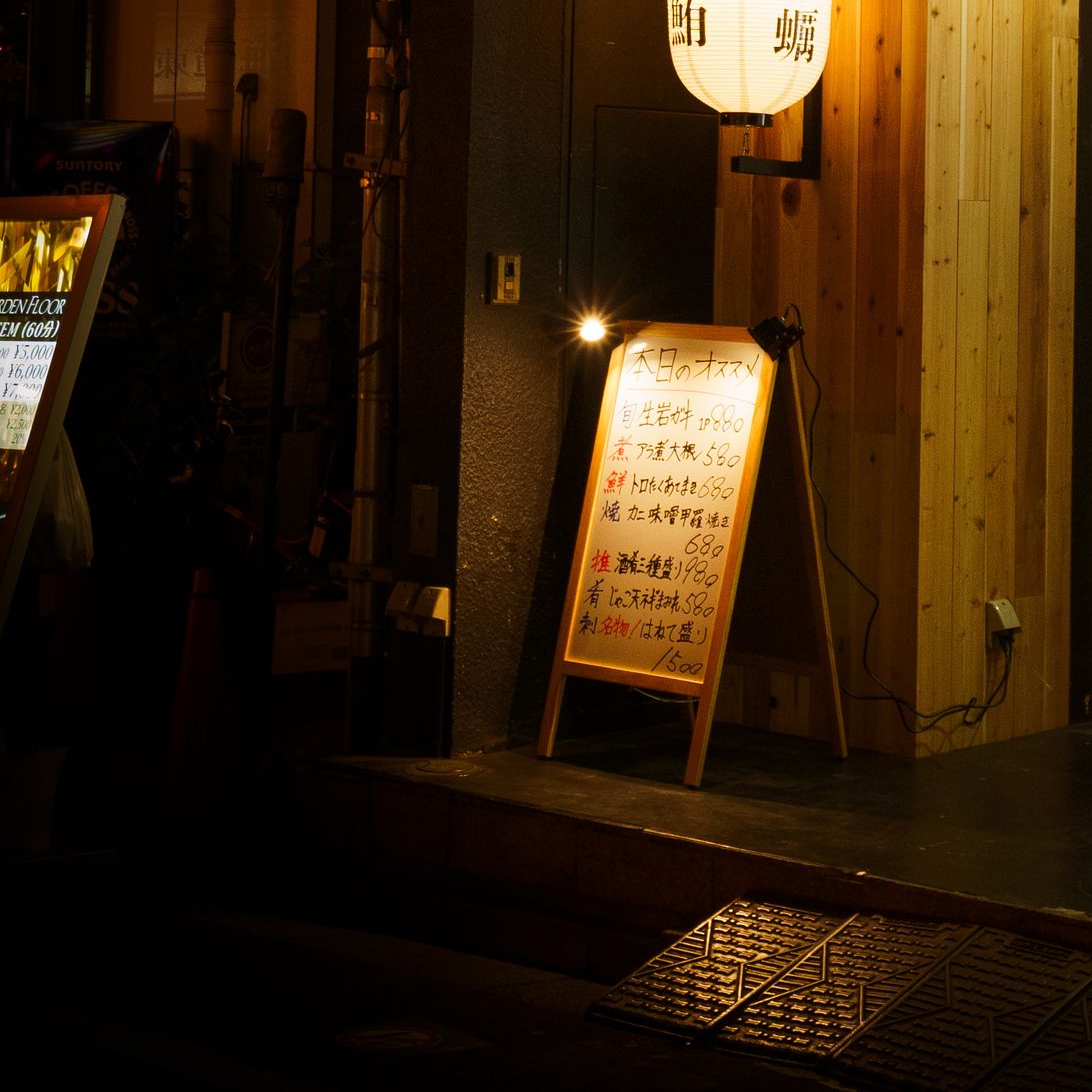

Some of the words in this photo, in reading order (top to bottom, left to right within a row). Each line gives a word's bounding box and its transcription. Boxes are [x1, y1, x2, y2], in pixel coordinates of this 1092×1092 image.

[55, 158, 125, 173] SUNTORY
[26, 296, 67, 315] FLOOR
[21, 320, 61, 339] (60分)
[14, 344, 54, 360] ¥5,000
[7, 363, 49, 380] ¥6,000
[626, 347, 760, 388] 本日のオススメ
[608, 434, 633, 462] 煮
[702, 441, 741, 468] 580
[602, 470, 628, 496] 鮮
[696, 475, 736, 501] 680
[684, 533, 725, 559] 680
[681, 556, 720, 588] 980
[681, 591, 716, 618] 580
